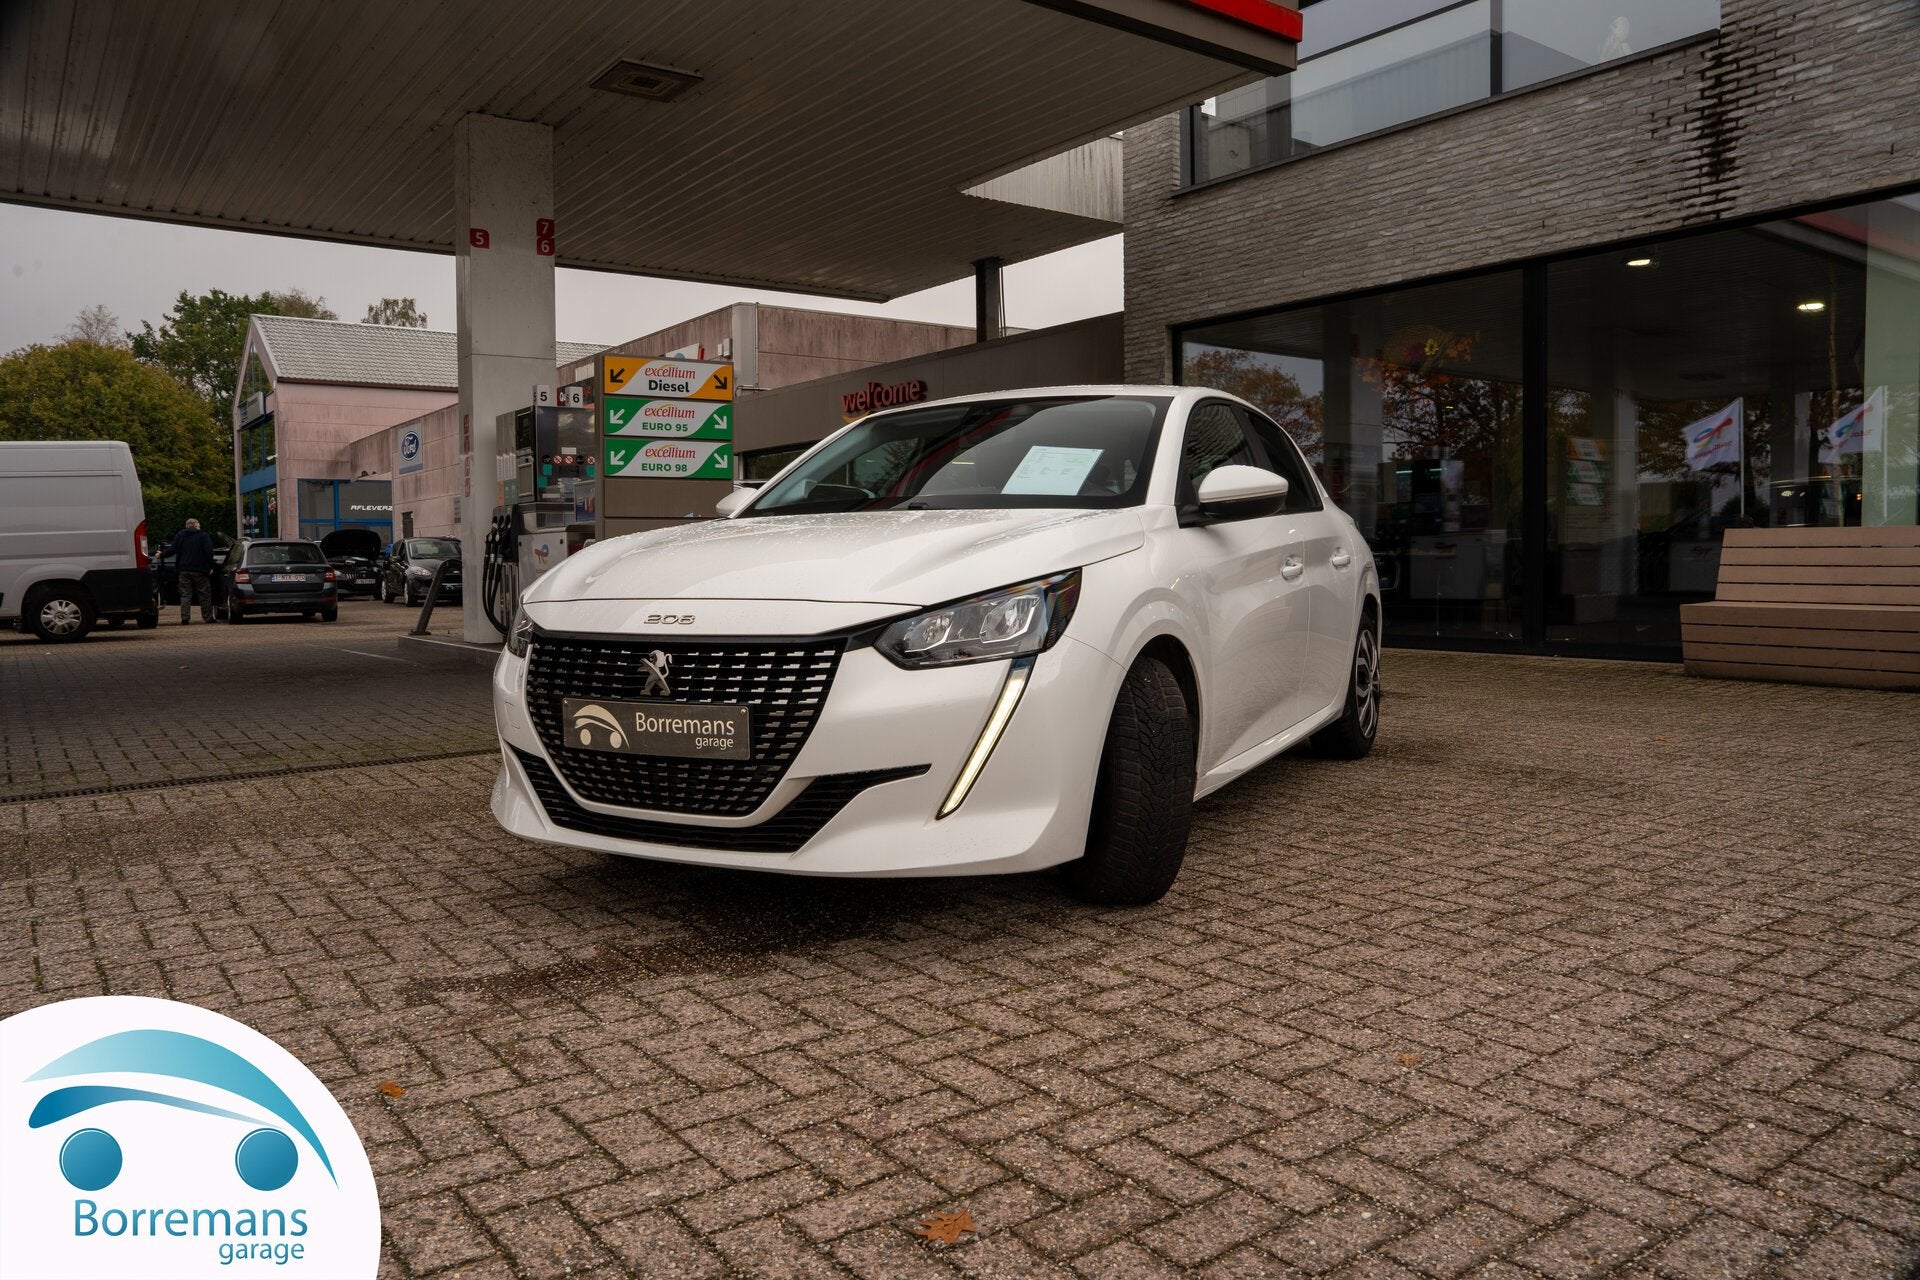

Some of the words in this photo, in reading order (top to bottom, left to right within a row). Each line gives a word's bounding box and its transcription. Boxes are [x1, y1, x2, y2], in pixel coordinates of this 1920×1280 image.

[541, 222, 550, 235] 7
[475, 231, 484, 245] 5
[541, 240, 550, 253] 6
[644, 366, 696, 380] excellium
[648, 379, 690, 393] Diesel
[540, 391, 548, 402] 5
[572, 393, 580, 404] 6
[644, 406, 695, 419] excellium
[642, 422, 672, 431] EURO
[675, 423, 688, 432] 95
[645, 446, 696, 459] excellium
[641, 463, 672, 472] EURO
[675, 463, 688, 472] 98
[643, 614, 696, 625] 208
[635, 711, 735, 736] Borremans
[695, 736, 734, 750] garage
